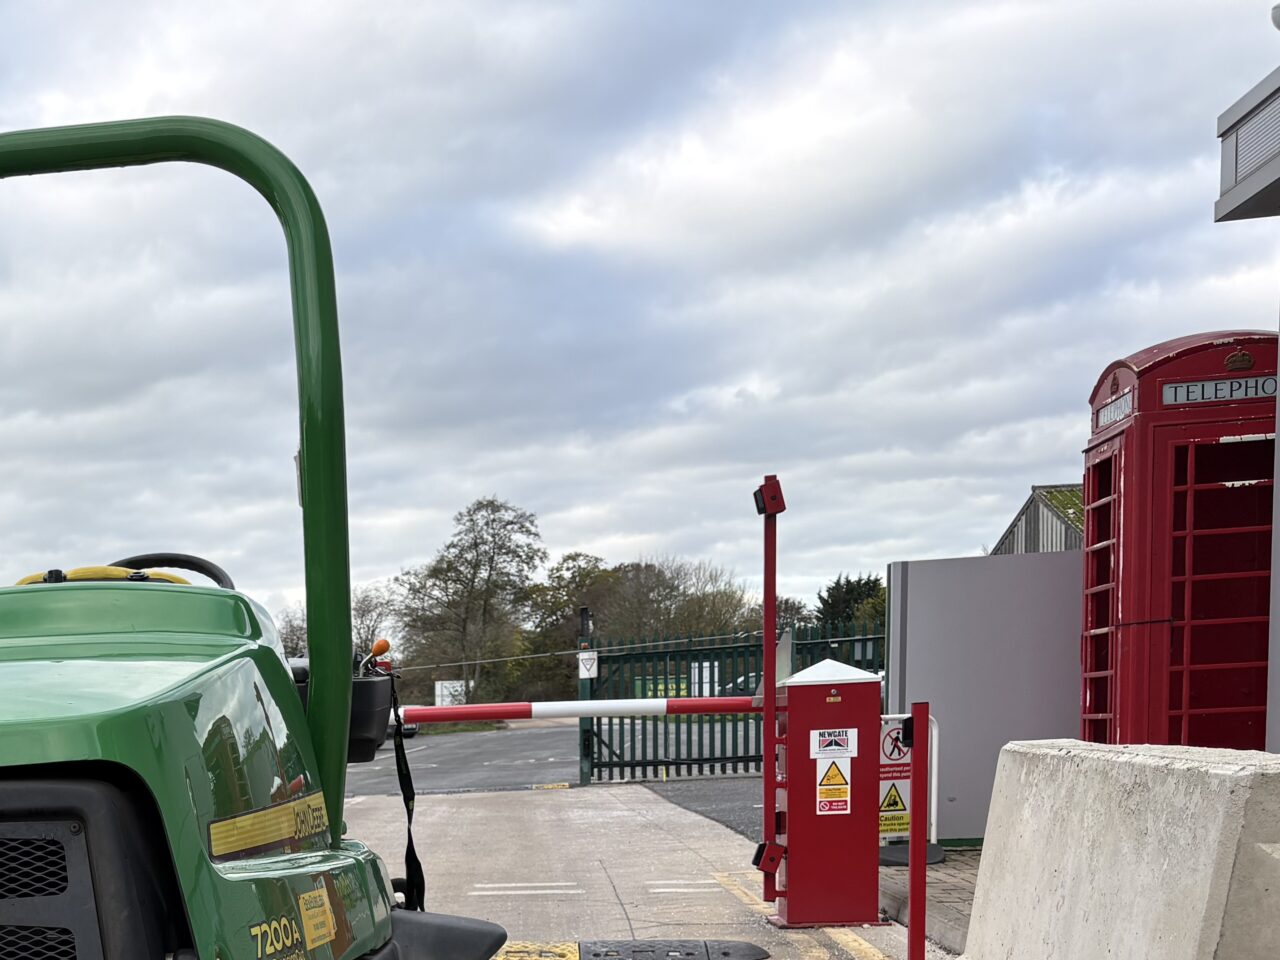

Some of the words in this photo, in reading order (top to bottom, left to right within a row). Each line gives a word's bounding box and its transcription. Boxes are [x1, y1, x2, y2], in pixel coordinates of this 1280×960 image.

[1168, 377, 1277, 403] TELEPHO
[819, 730, 849, 738] NEWGATE
[250, 916, 302, 959] 7200A
